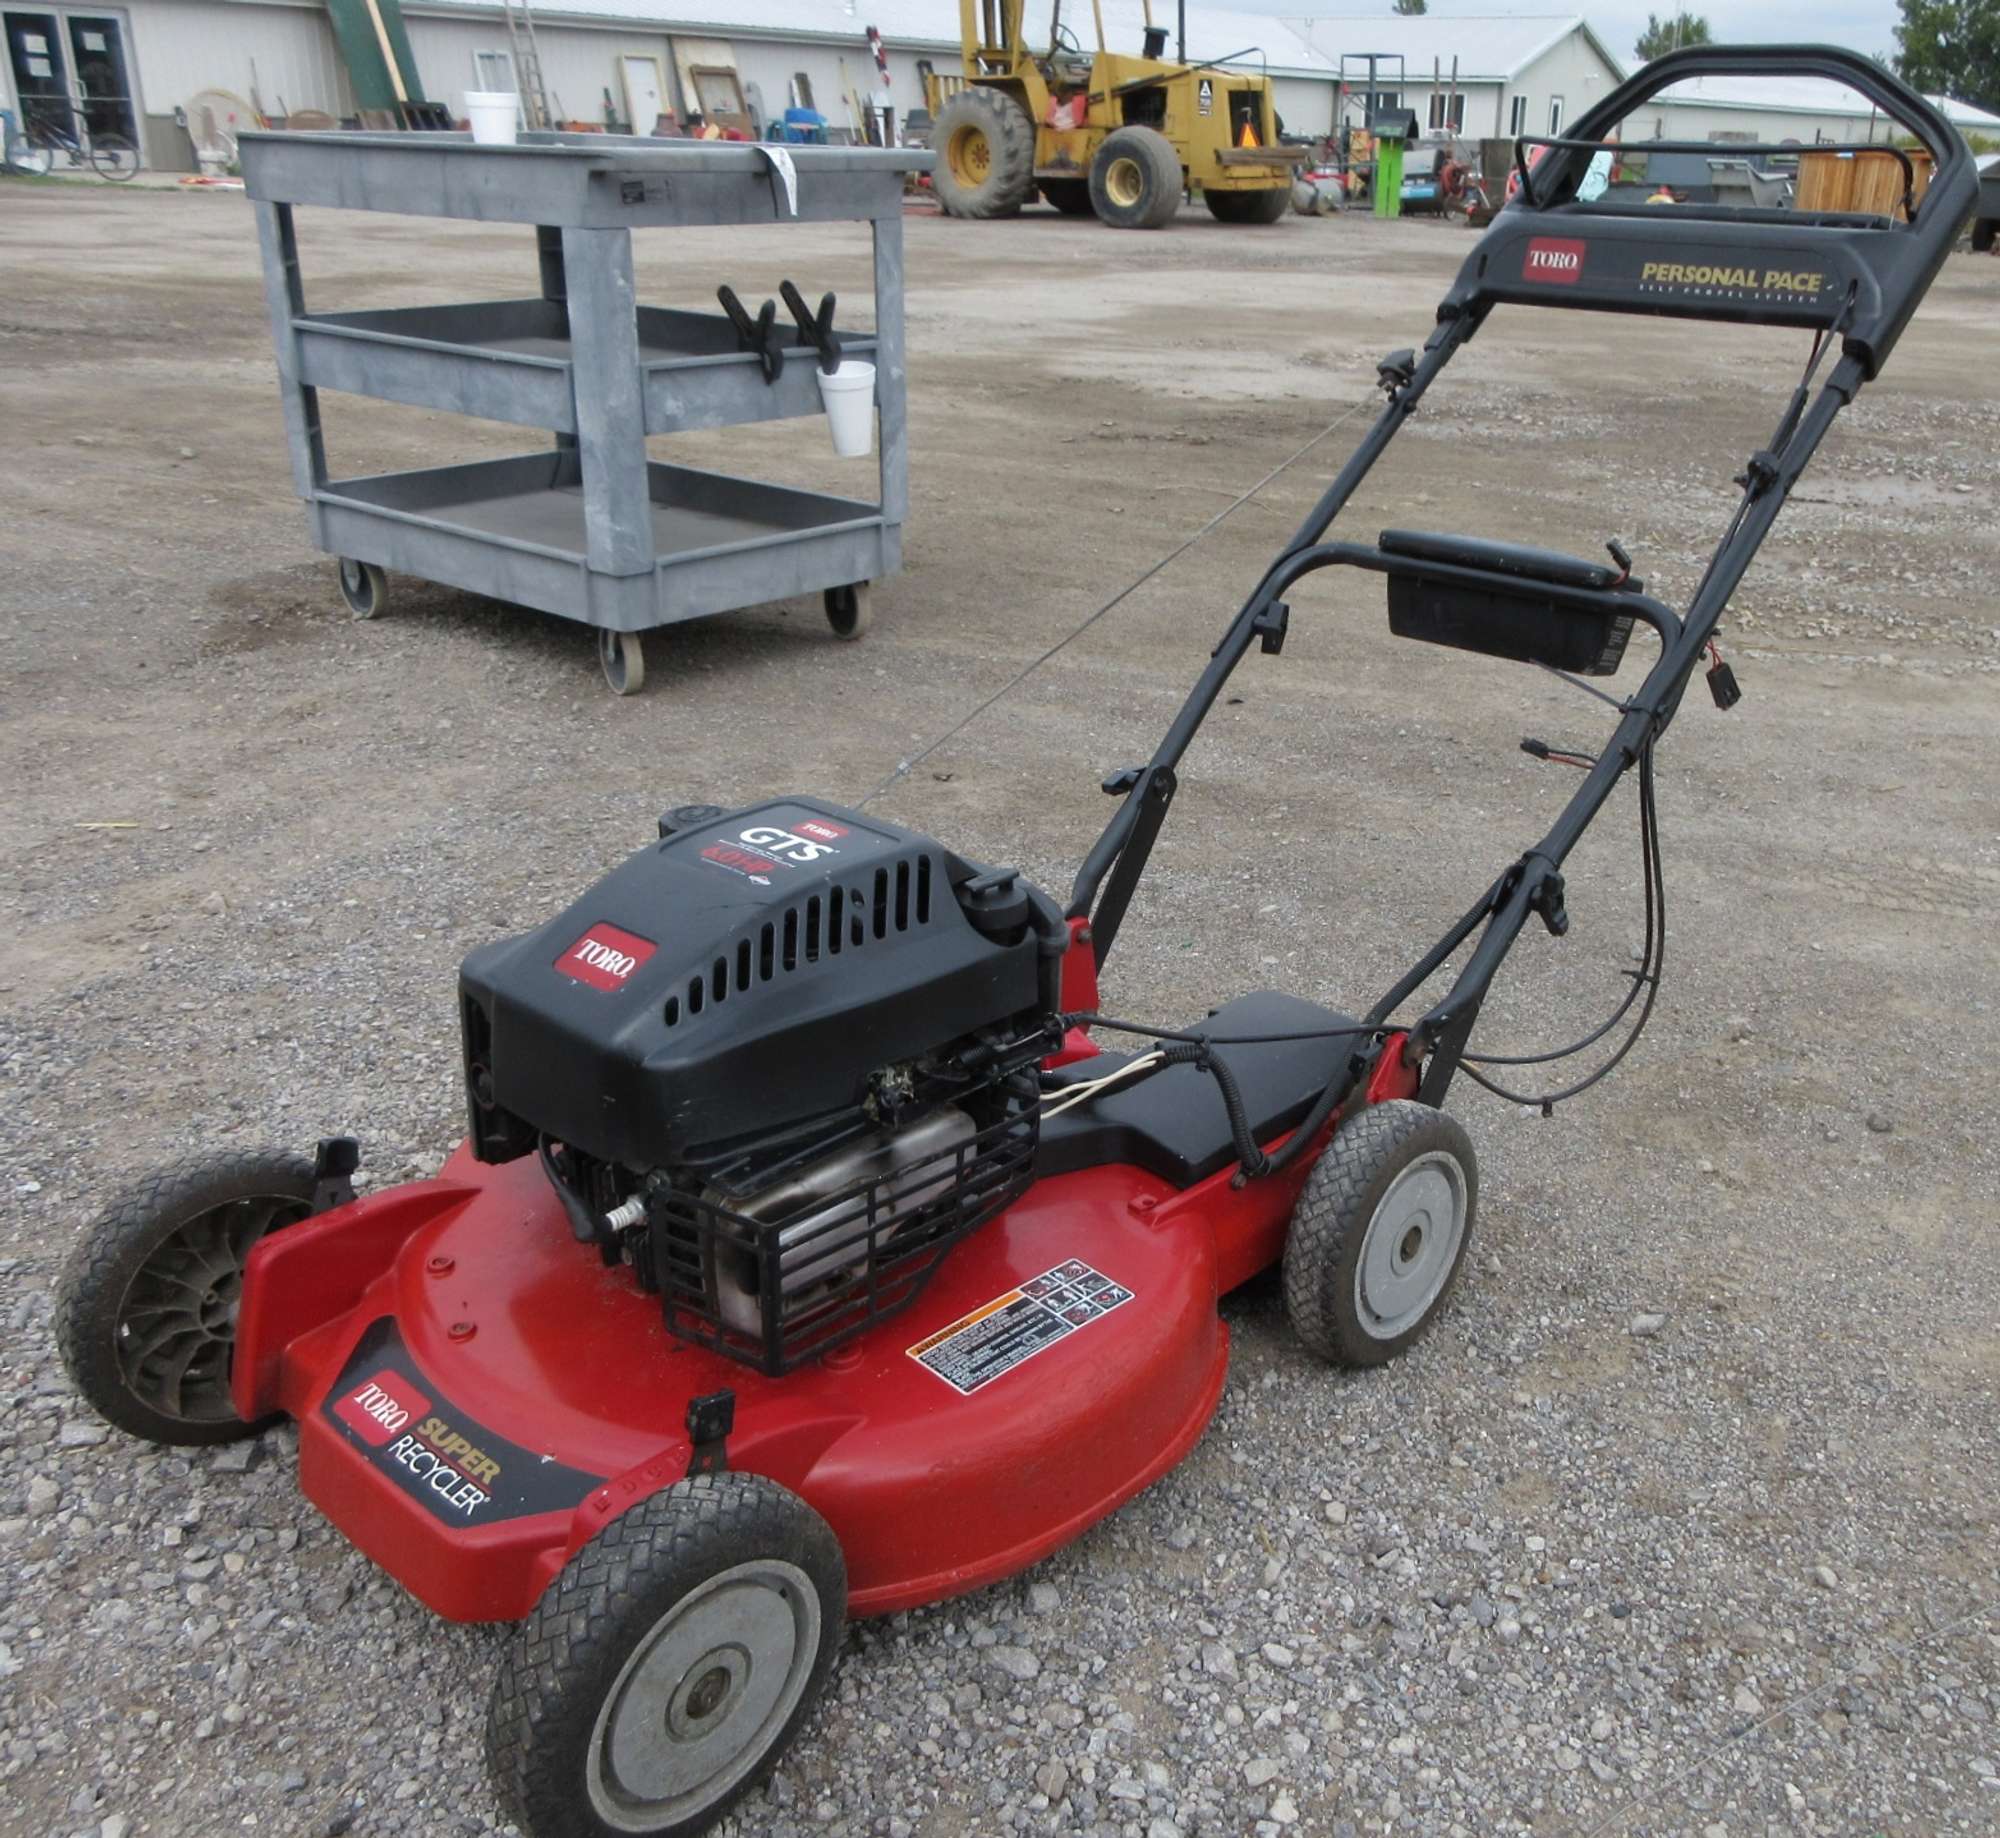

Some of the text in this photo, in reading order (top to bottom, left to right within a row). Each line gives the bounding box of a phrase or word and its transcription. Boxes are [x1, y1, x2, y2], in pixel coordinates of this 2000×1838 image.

[1529, 250, 1579, 270] TORO
[1641, 262, 1823, 293] PERSONAL PACE
[739, 826, 835, 861] GTS
[573, 938, 636, 977] TORO
[353, 1382, 409, 1432] TORO
[417, 1417, 502, 1485] SUPER
